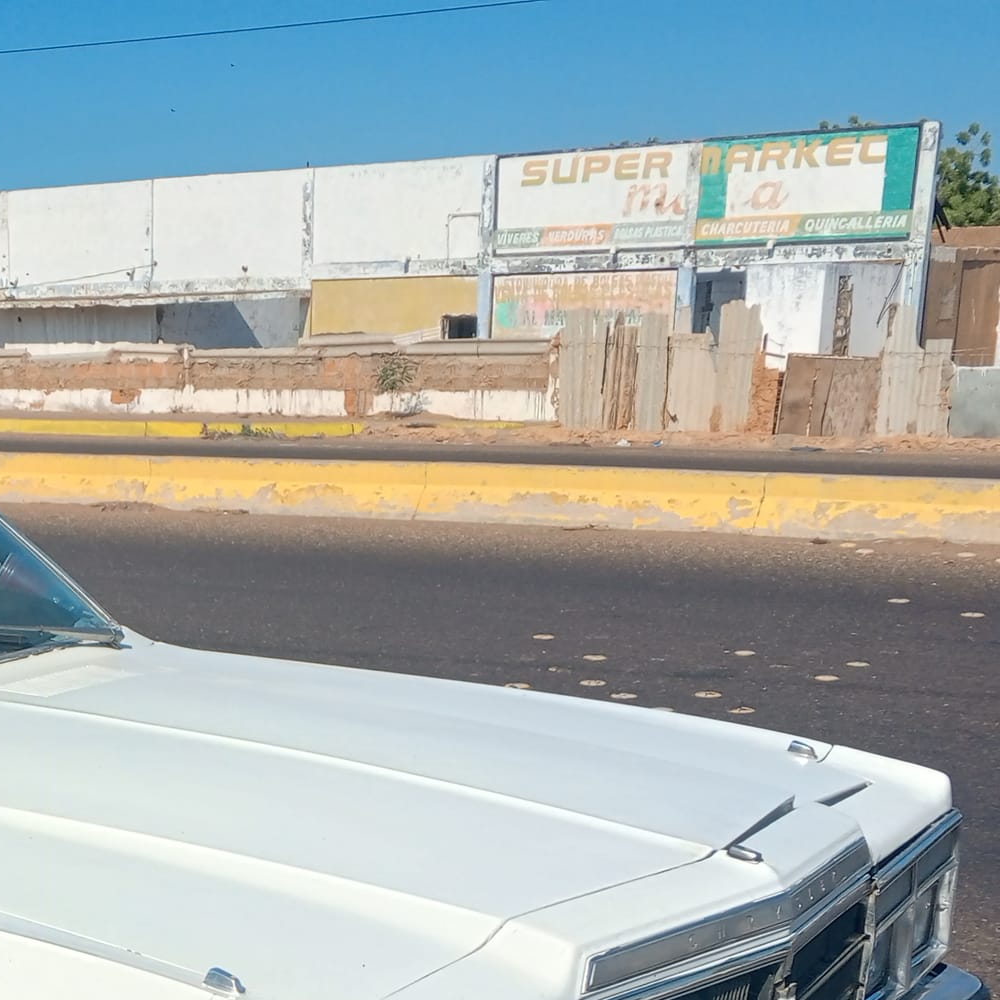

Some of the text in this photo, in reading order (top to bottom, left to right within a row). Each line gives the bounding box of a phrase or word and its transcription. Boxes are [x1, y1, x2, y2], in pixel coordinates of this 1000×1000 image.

[521, 151, 673, 187] SUPER
[702, 219, 790, 236] CHARCUTERIA
[804, 214, 908, 232] QUINCALLERIA
